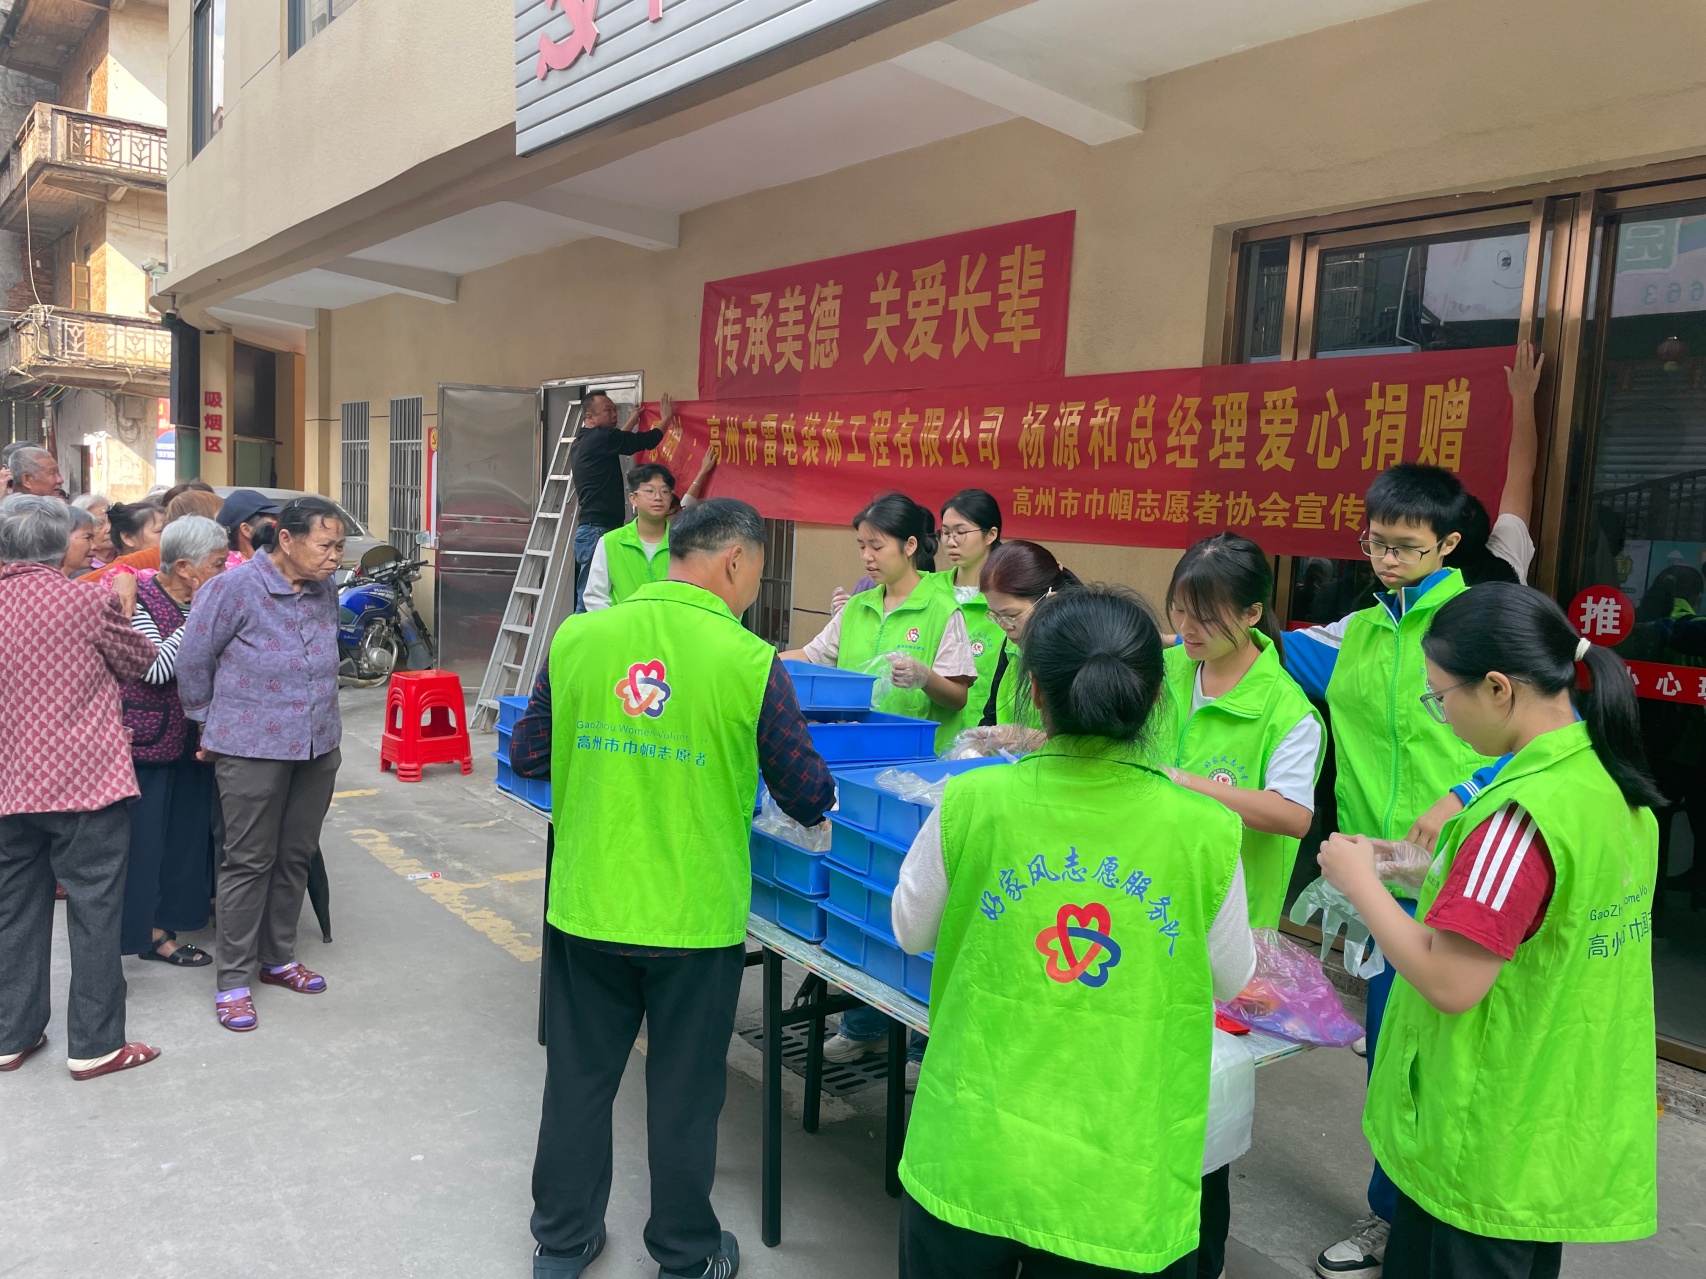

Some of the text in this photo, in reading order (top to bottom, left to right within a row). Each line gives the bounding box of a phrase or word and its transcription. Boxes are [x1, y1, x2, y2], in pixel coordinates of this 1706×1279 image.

[714, 243, 1046, 378] 传承美德 关爱长辈
[204, 391, 223, 453] 吸烟区
[1017, 377, 1471, 474] 杨源和总经理爱心捐赠
[1012, 486, 1366, 532] 高州市巾帼志愿者协会宣传
[1580, 596, 1622, 636] 推
[576, 720, 616, 732] GaoZhou
[618, 724, 656, 737] Women
[576, 734, 707, 767] 高州市巾帼志愿者
[980, 846, 1180, 957] 好家风志愿服务队
